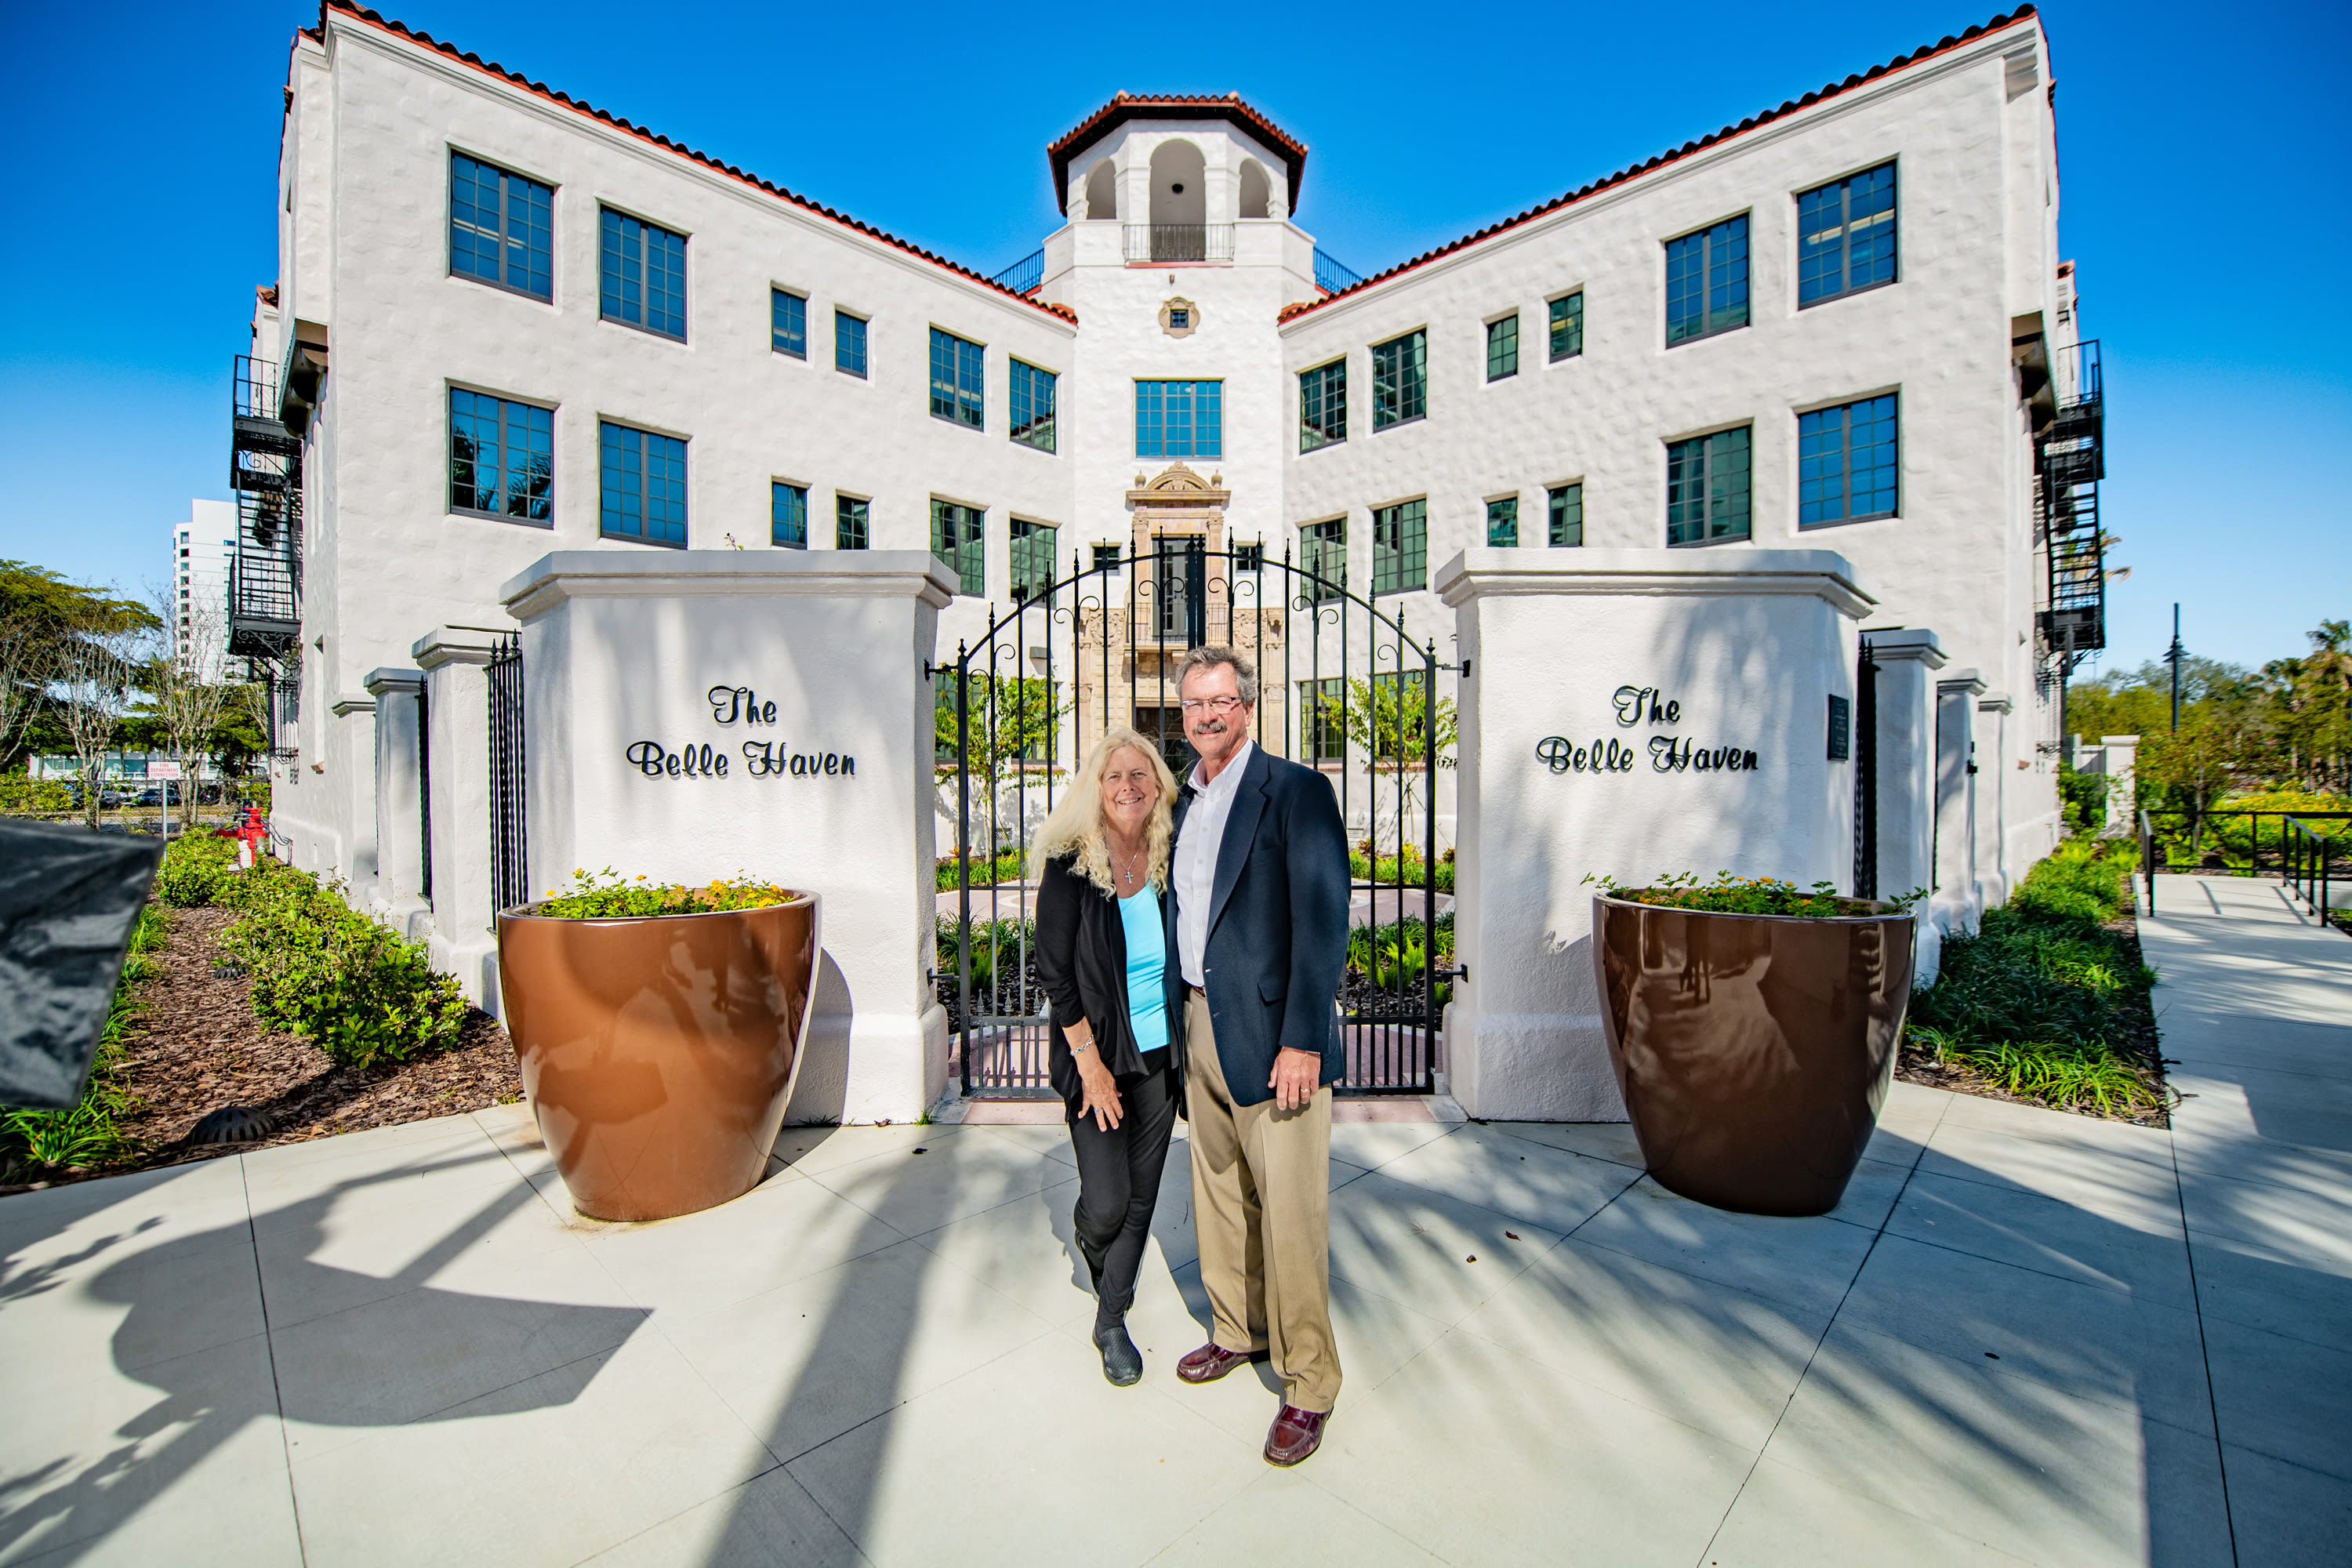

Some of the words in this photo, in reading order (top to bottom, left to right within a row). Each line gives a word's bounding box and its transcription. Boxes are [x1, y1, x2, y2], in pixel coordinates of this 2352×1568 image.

[707, 684, 777, 724] The
[1612, 684, 1681, 724] The
[626, 740, 729, 776] Belle
[742, 740, 856, 776] Haven
[1537, 735, 1633, 772] Belle
[1648, 735, 1759, 771] Haven
